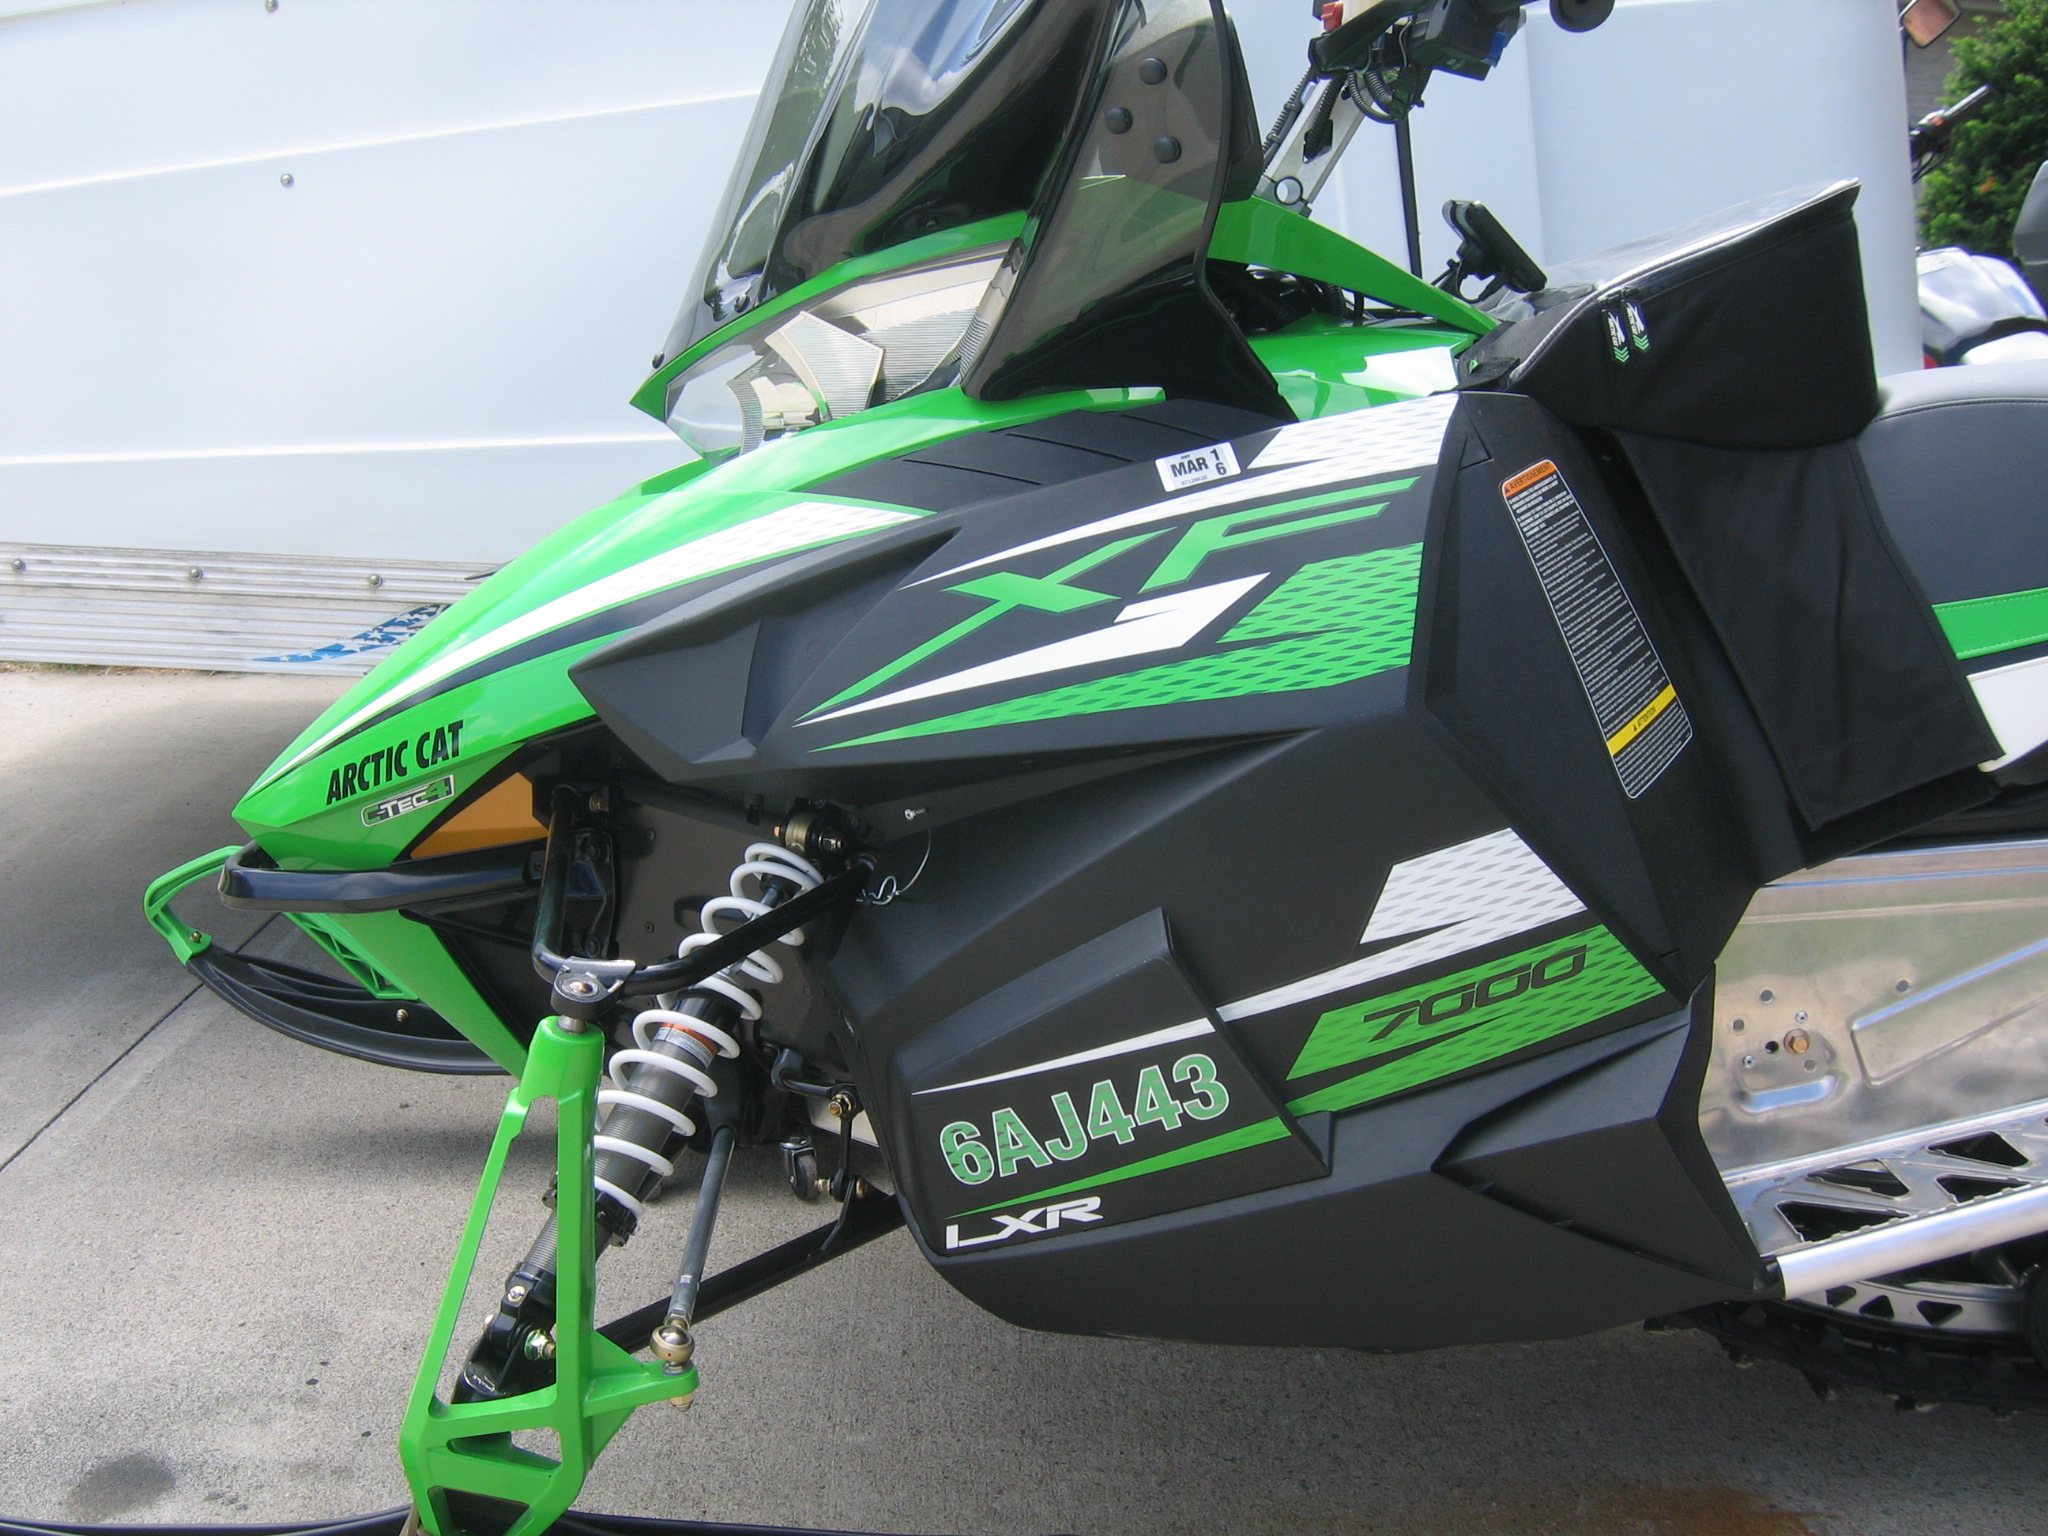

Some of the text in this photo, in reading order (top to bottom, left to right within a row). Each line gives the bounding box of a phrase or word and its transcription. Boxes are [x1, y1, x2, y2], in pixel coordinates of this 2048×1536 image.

[1170, 457, 1209, 477] MAR
[1509, 461, 1552, 491] AVERTISSEMENT
[1637, 705, 1657, 728] ATTENTION
[326, 719, 464, 806] ARCTIC CAT
[1363, 944, 1588, 1043] 7000
[940, 1053, 1230, 1186] 6AJ443
[945, 1196, 1104, 1250] LXR
